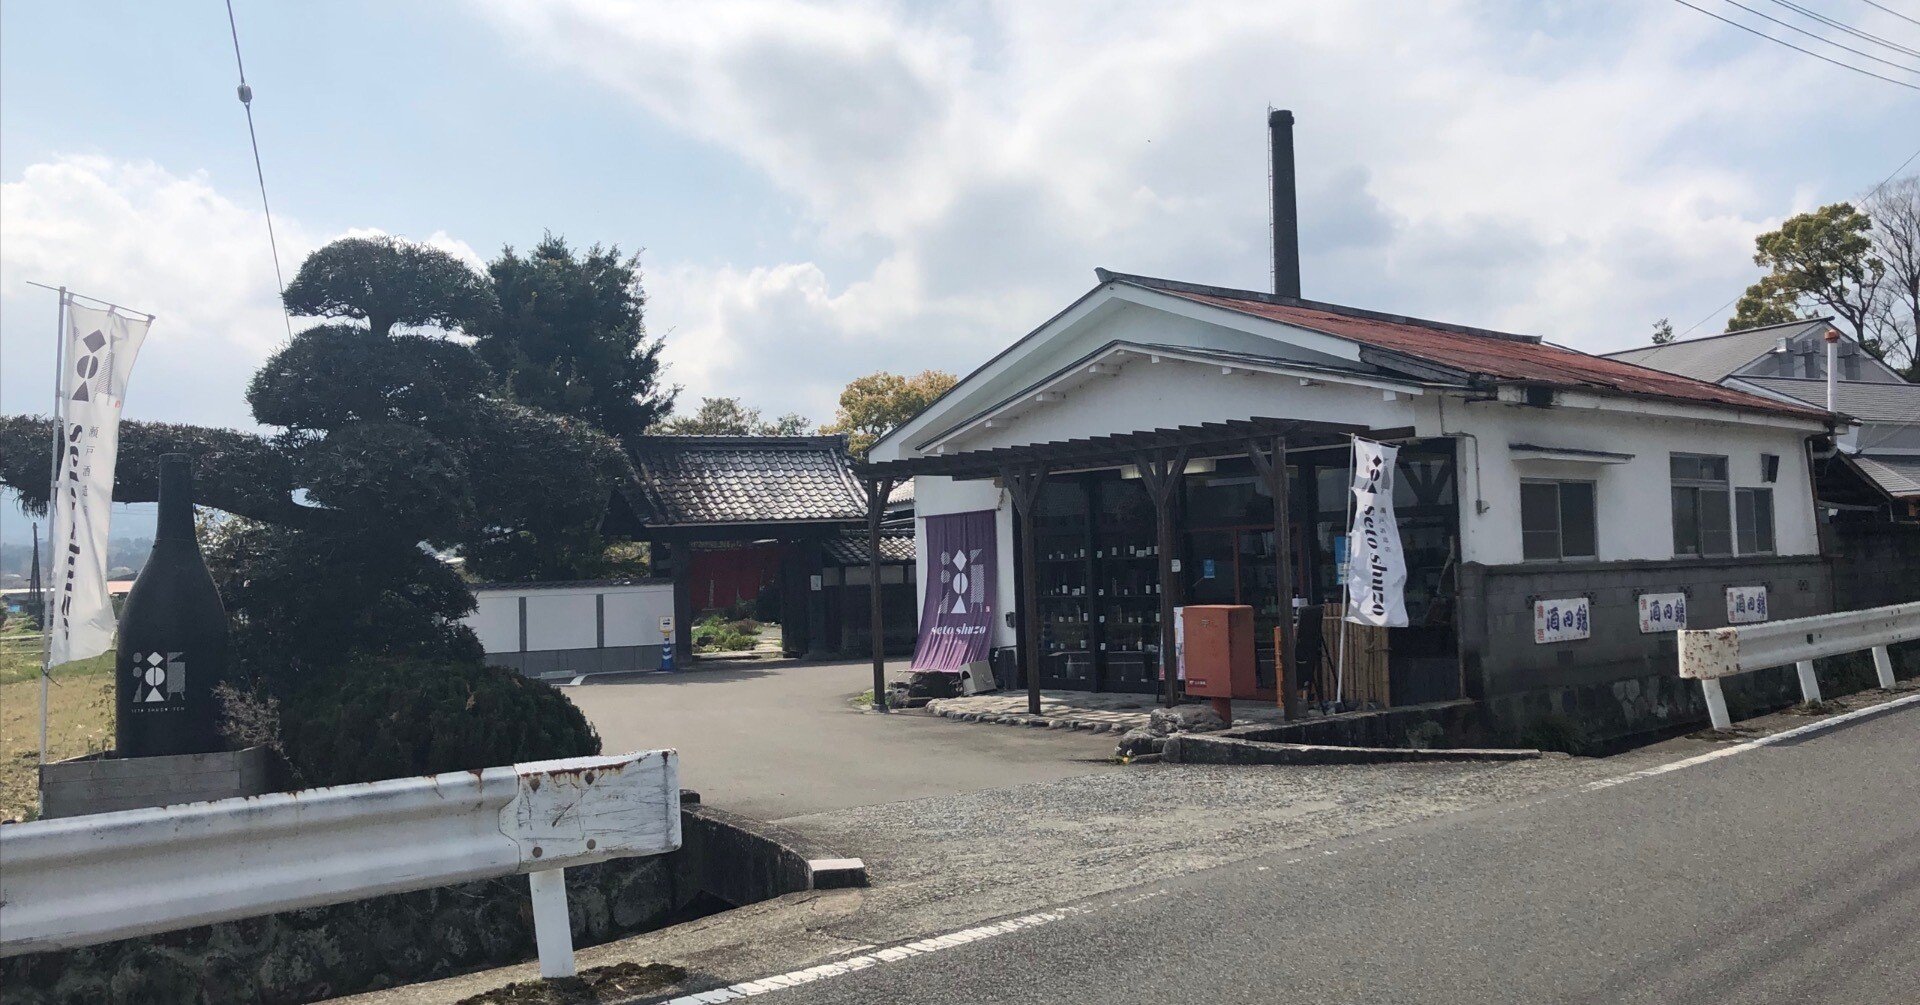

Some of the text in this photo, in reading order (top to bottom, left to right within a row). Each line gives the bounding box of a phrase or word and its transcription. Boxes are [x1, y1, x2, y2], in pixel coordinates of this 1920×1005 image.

[1363, 504, 1388, 616] seto shuzo
[931, 623, 987, 634] seto shuzo
